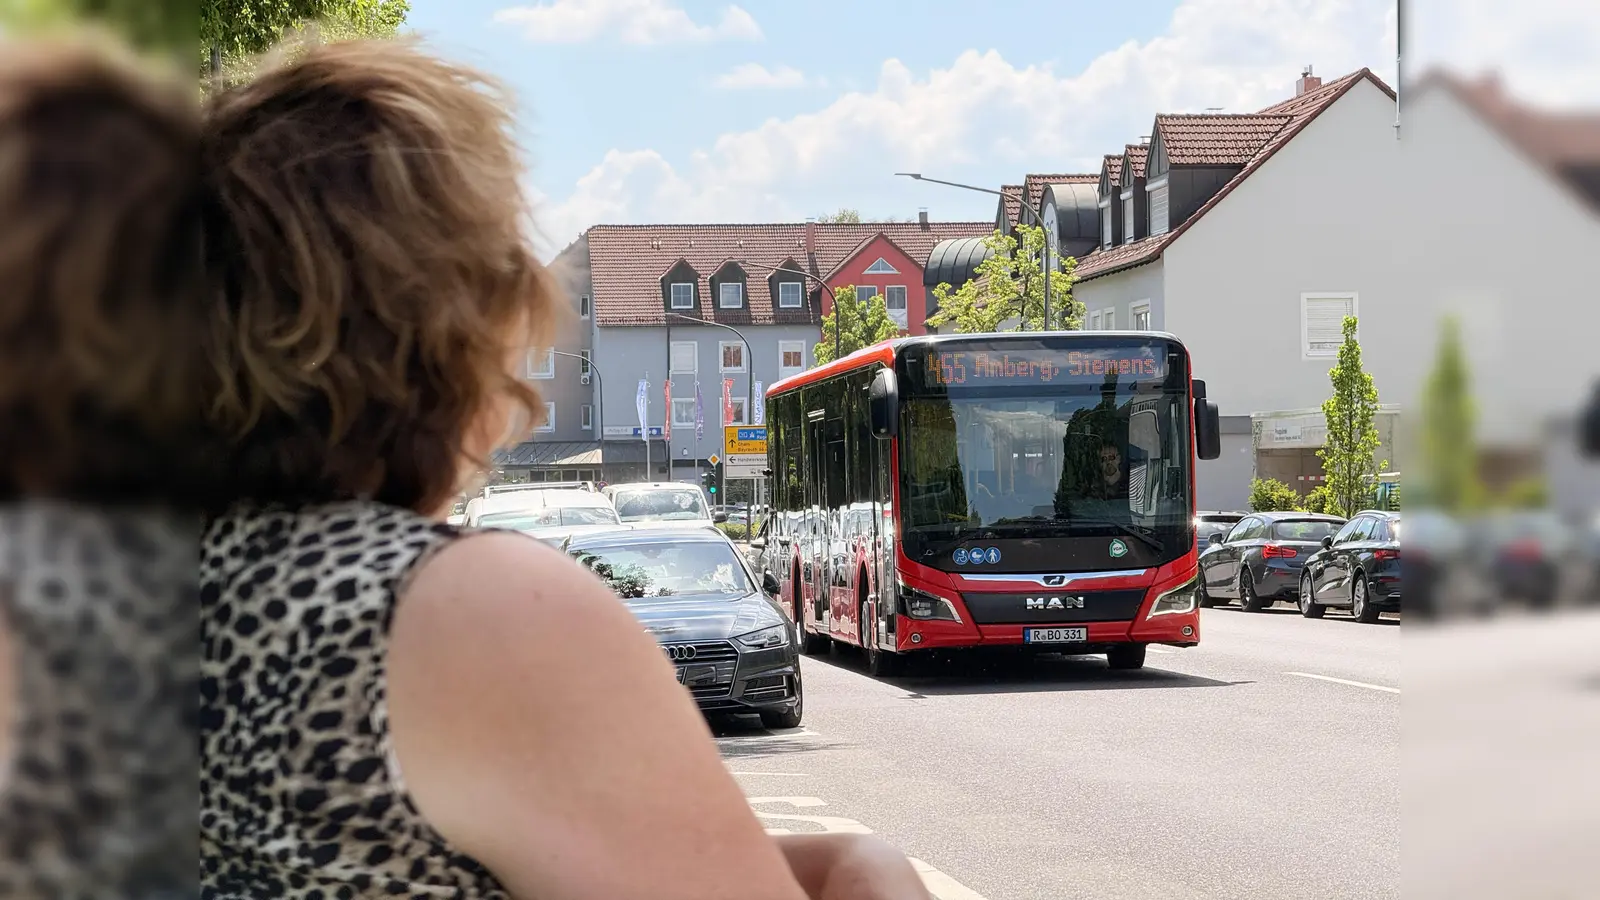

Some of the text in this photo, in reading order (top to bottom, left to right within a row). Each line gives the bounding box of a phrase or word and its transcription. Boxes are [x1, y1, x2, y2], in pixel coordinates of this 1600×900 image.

[927, 351, 1156, 384] 455 Amberg, Siemens
[1026, 596, 1085, 610] MAN
[1033, 629, 1083, 640] R BO 331
